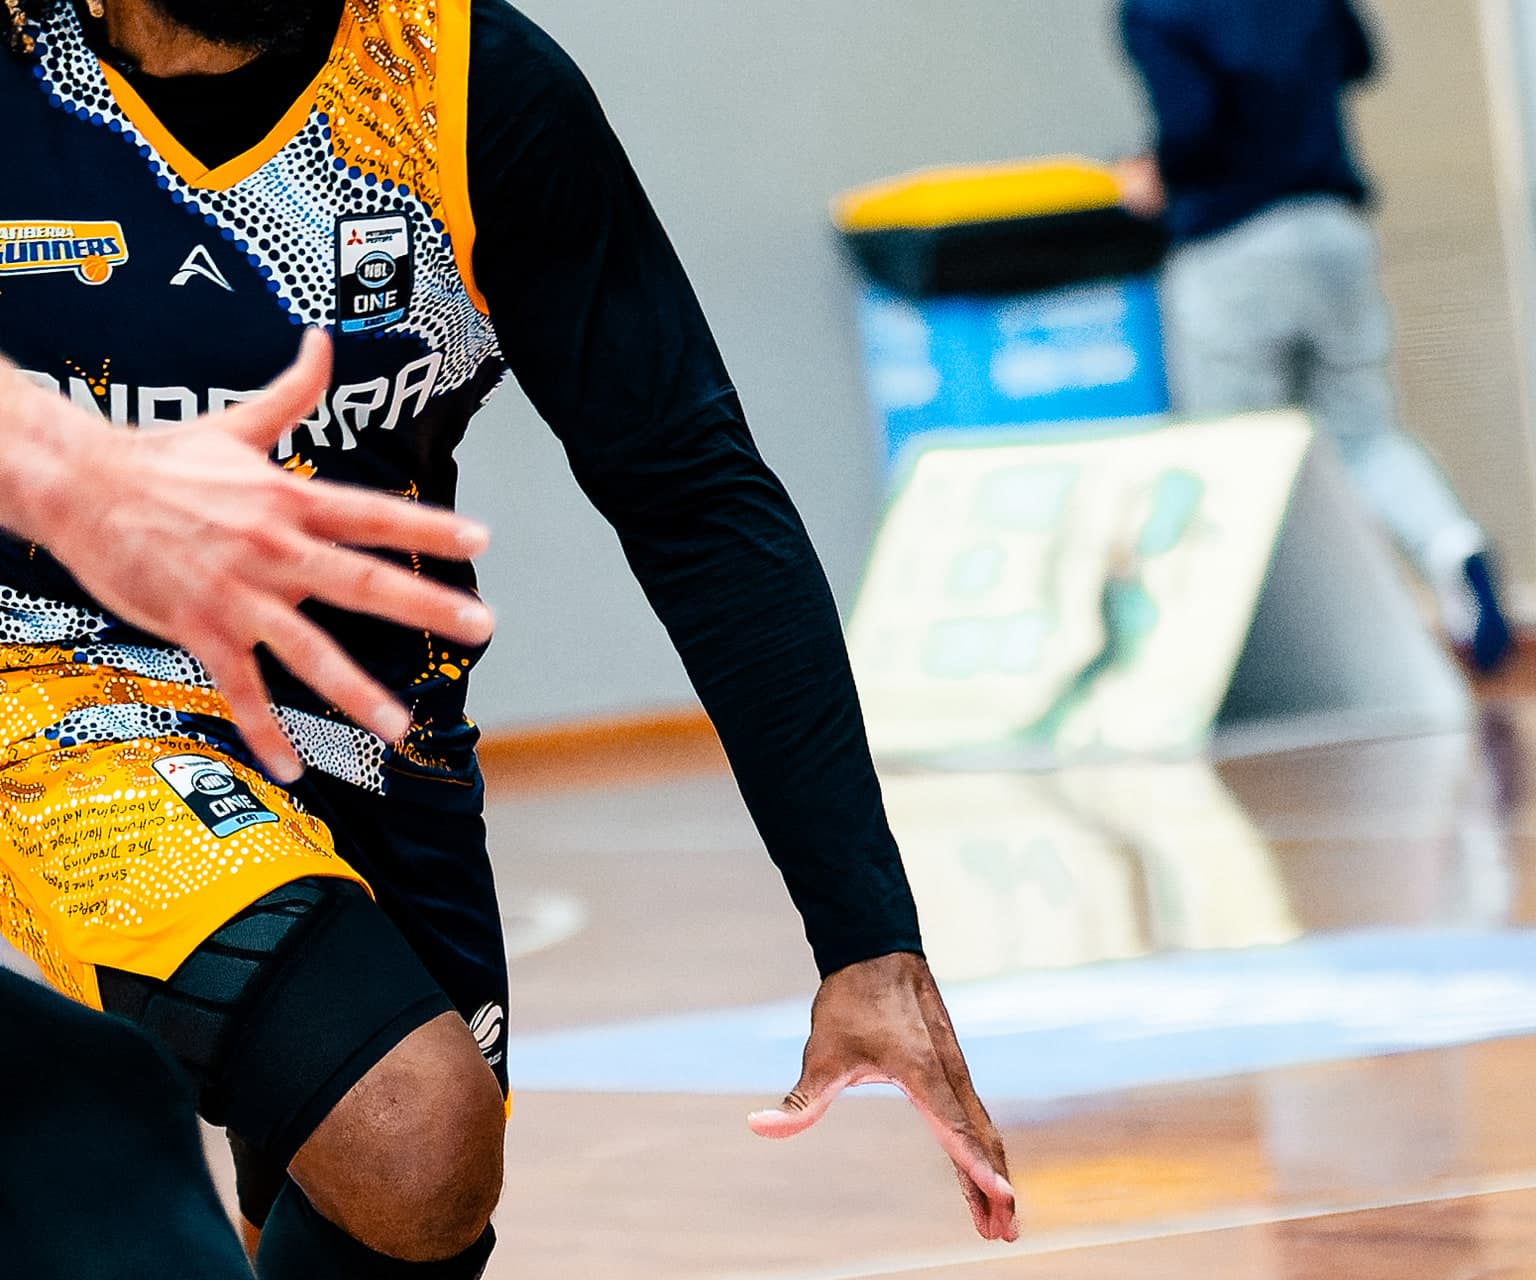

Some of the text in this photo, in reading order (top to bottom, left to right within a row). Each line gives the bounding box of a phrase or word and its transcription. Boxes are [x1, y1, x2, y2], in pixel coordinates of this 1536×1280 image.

[353, 289, 398, 314] ONE
[208, 793, 257, 818] ONE
[42, 808, 83, 831] Nation
[106, 816, 166, 839] Cultural
[49, 826, 104, 852] Heritage
[62, 837, 158, 872] The Dreaming
[72, 879, 95, 892] time
[67, 898, 109, 917] Respect
